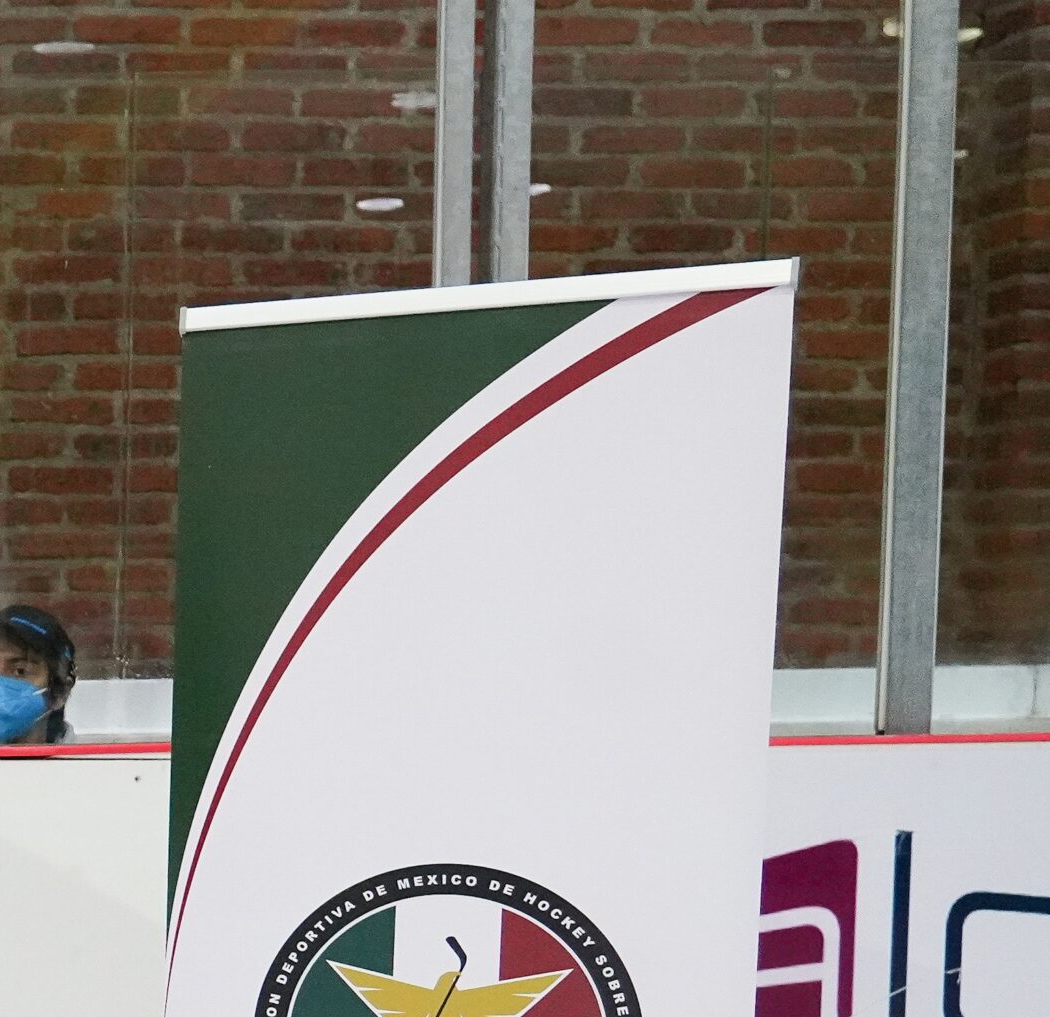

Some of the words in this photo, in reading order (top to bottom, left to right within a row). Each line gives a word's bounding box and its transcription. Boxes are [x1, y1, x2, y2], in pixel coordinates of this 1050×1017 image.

[275, 900, 356, 985] DEPORTIVA
[362, 884, 388, 902] DE
[397, 874, 478, 891] MEXICO
[489, 879, 516, 897] DE
[524, 891, 596, 949] HOCKEY
[595, 955, 630, 1017] SOBRE
